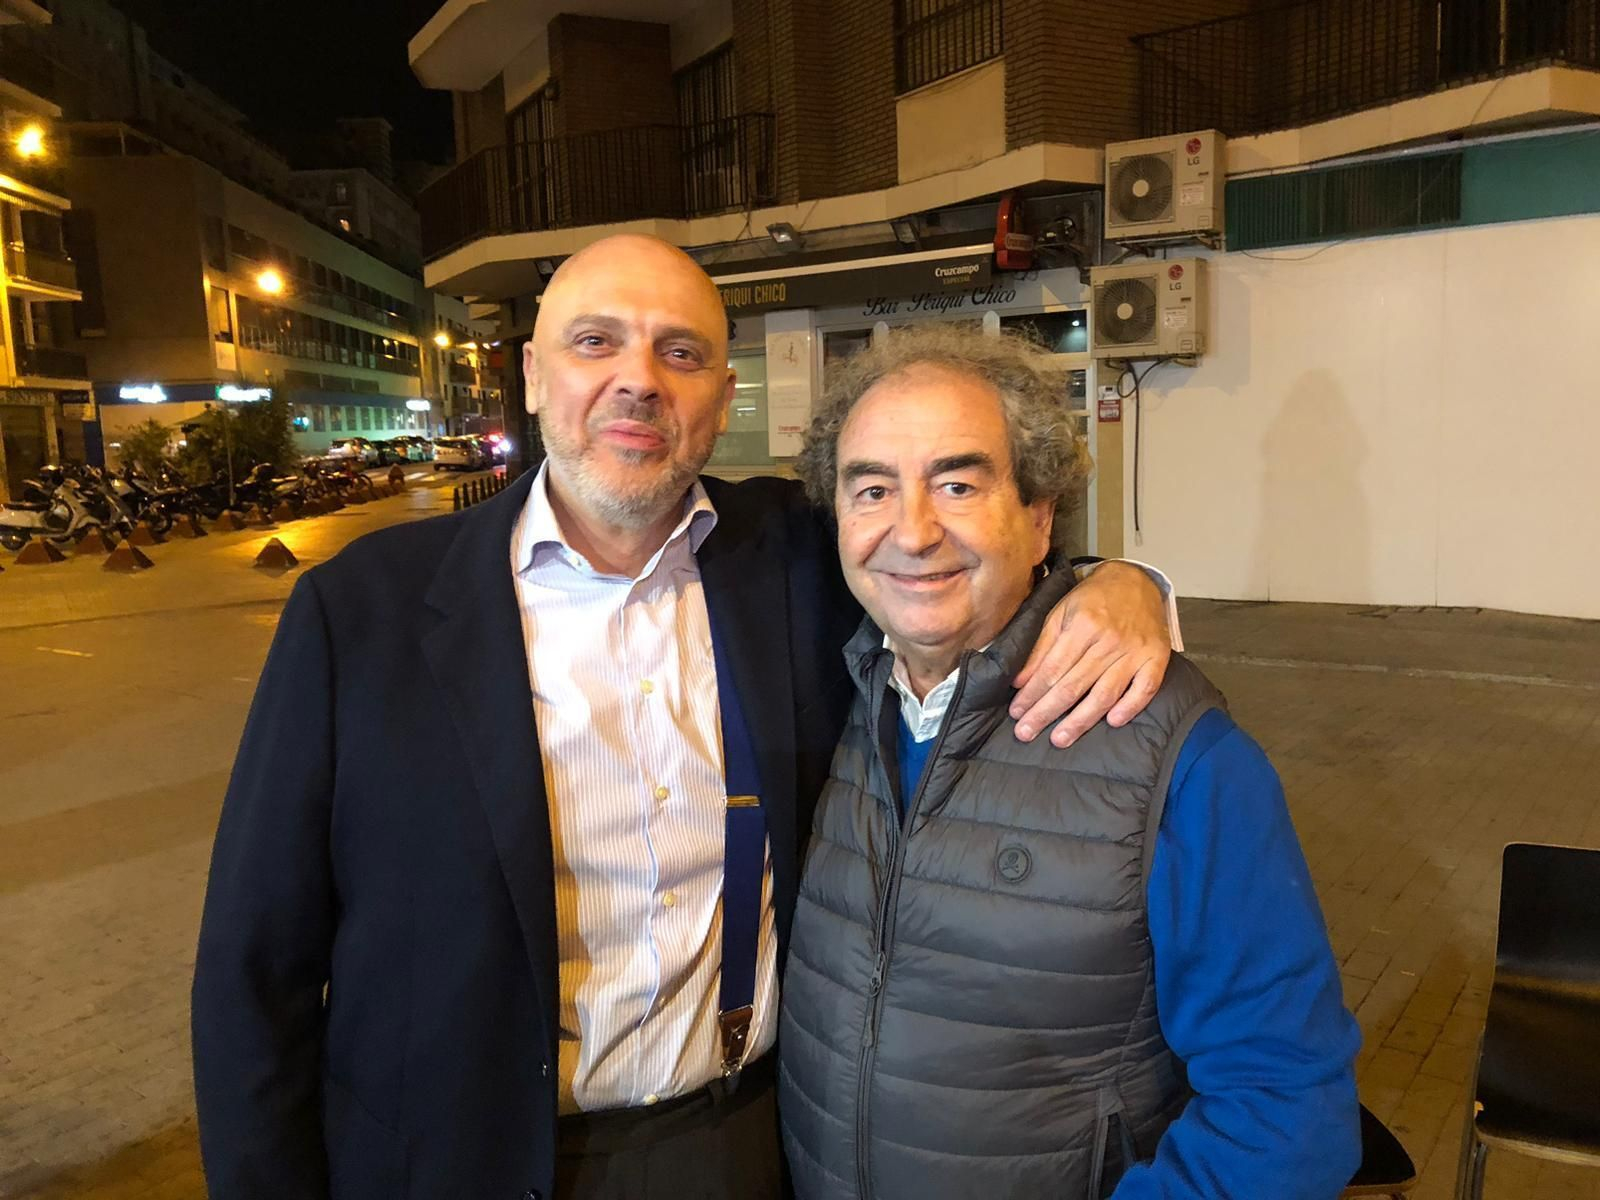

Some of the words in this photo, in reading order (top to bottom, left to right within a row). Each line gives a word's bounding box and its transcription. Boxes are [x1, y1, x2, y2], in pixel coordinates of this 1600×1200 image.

[1187, 156, 1200, 166] LG
[935, 264, 980, 278] Cruzcampo
[754, 283, 786, 304] CHICO
[1169, 282, 1182, 291] LG
[863, 296, 900, 316] Bar
[971, 284, 1017, 305] Chico
